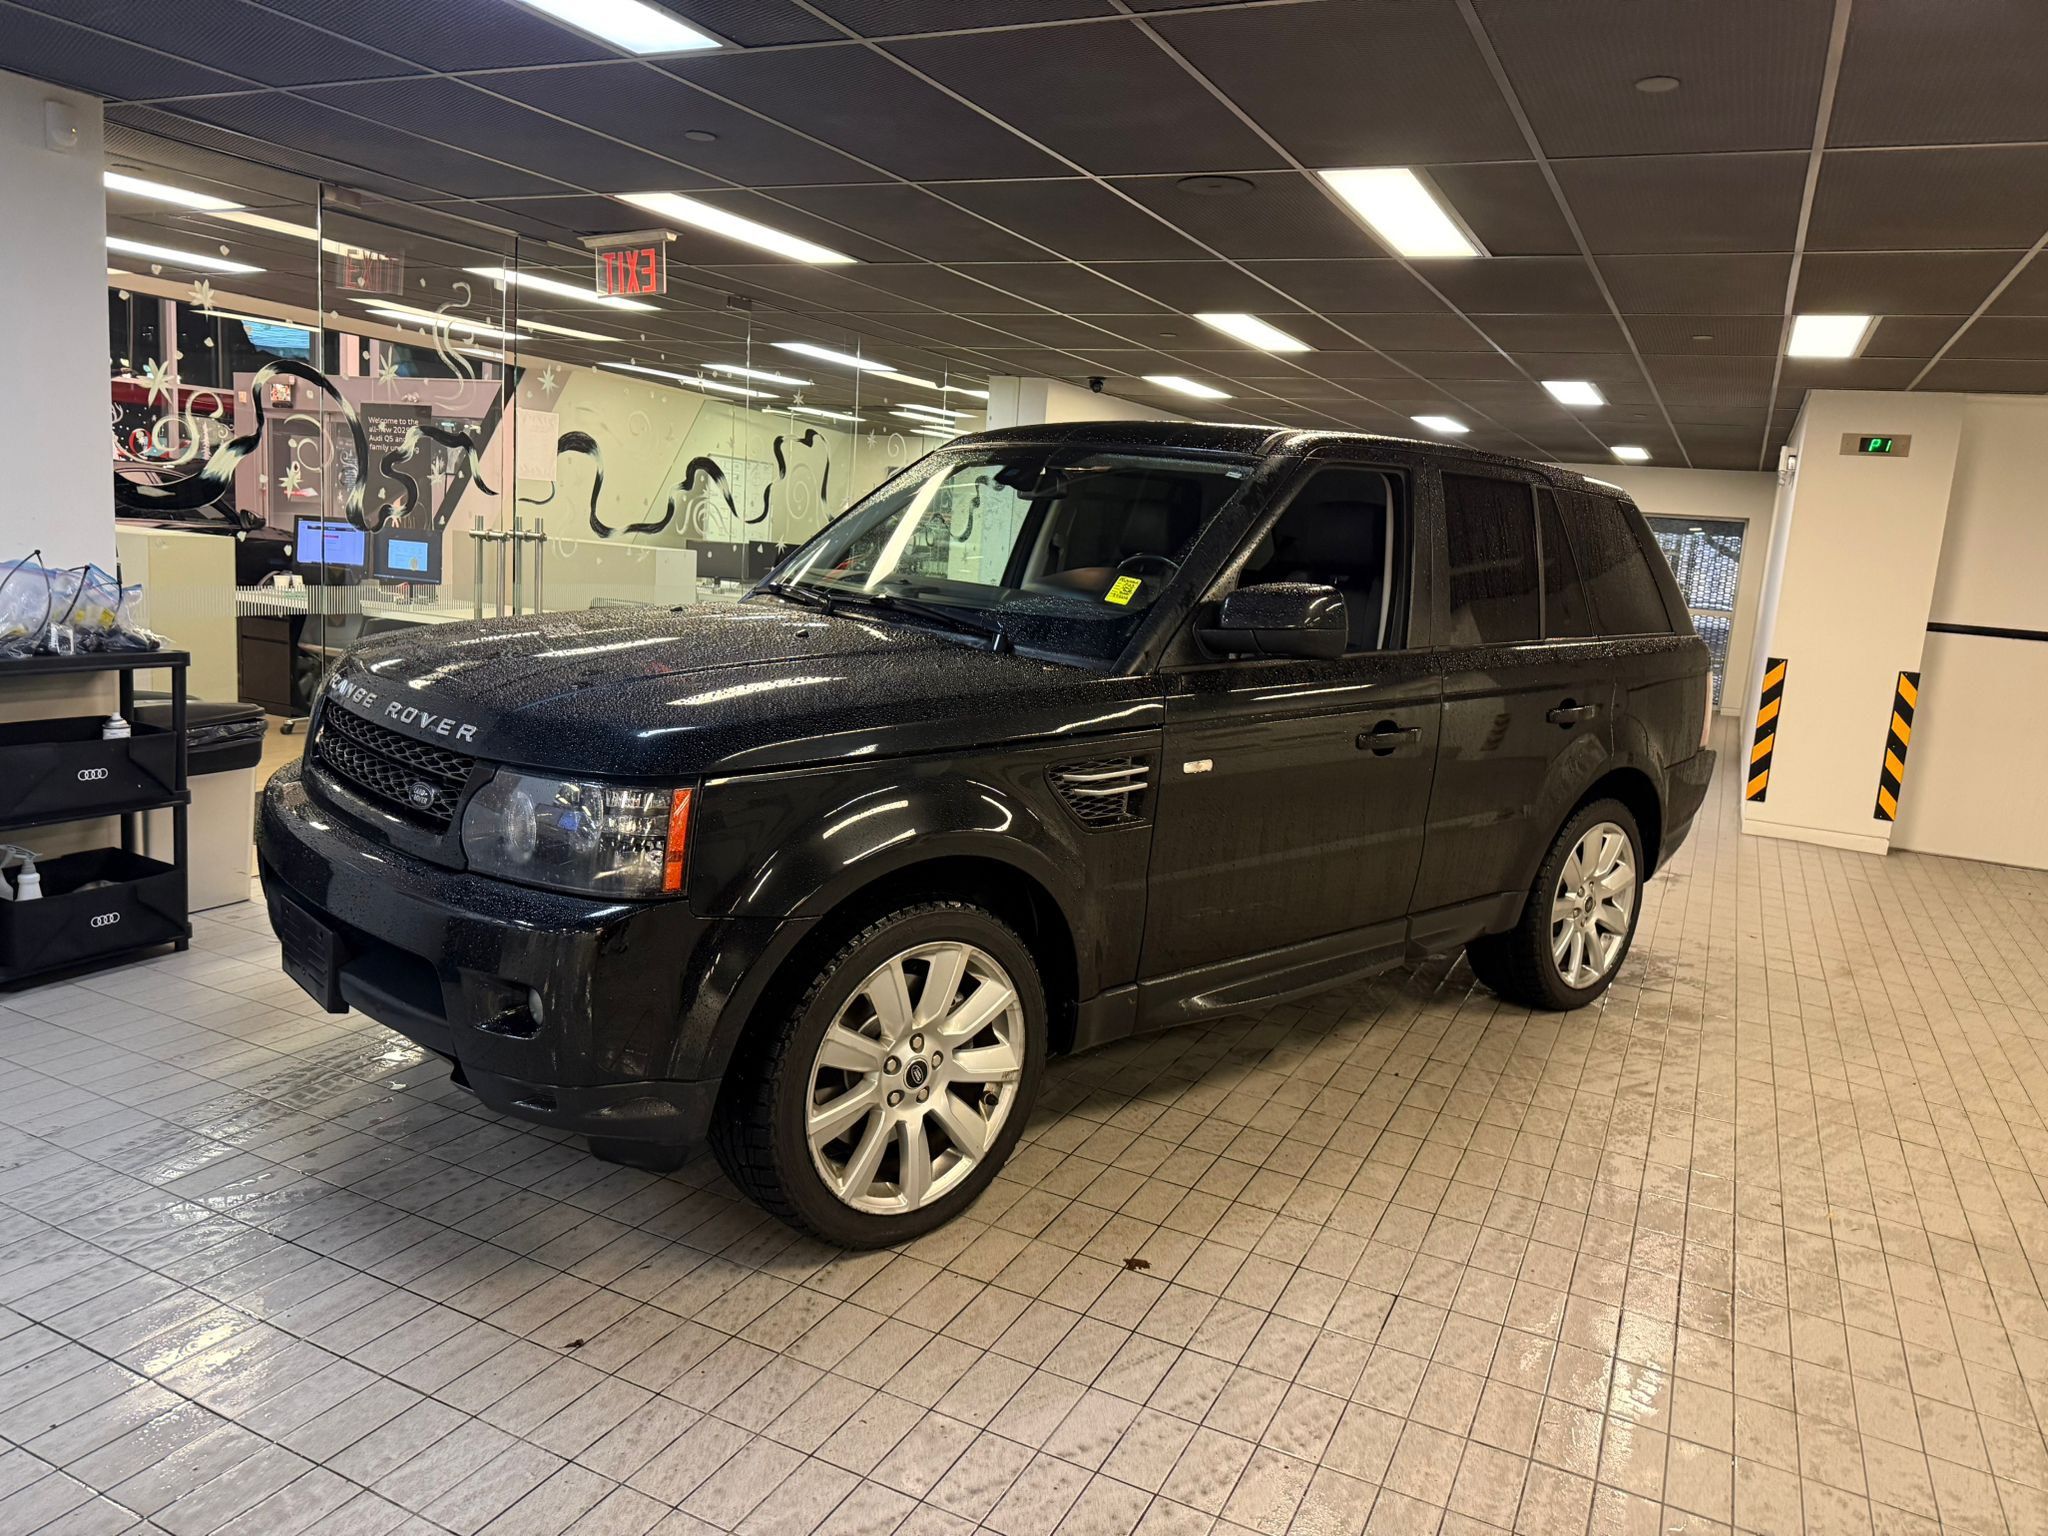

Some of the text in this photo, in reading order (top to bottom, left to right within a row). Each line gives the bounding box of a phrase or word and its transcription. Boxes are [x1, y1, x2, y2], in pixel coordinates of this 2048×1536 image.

[343, 249, 397, 293] EXIT
[368, 416, 398, 425] Welcome
[408, 418, 419, 426] the
[384, 435, 394, 443] Q5
[1868, 438, 1892, 452] P1
[369, 443, 390, 453] family
[329, 673, 477, 742] RANGE ROVER
